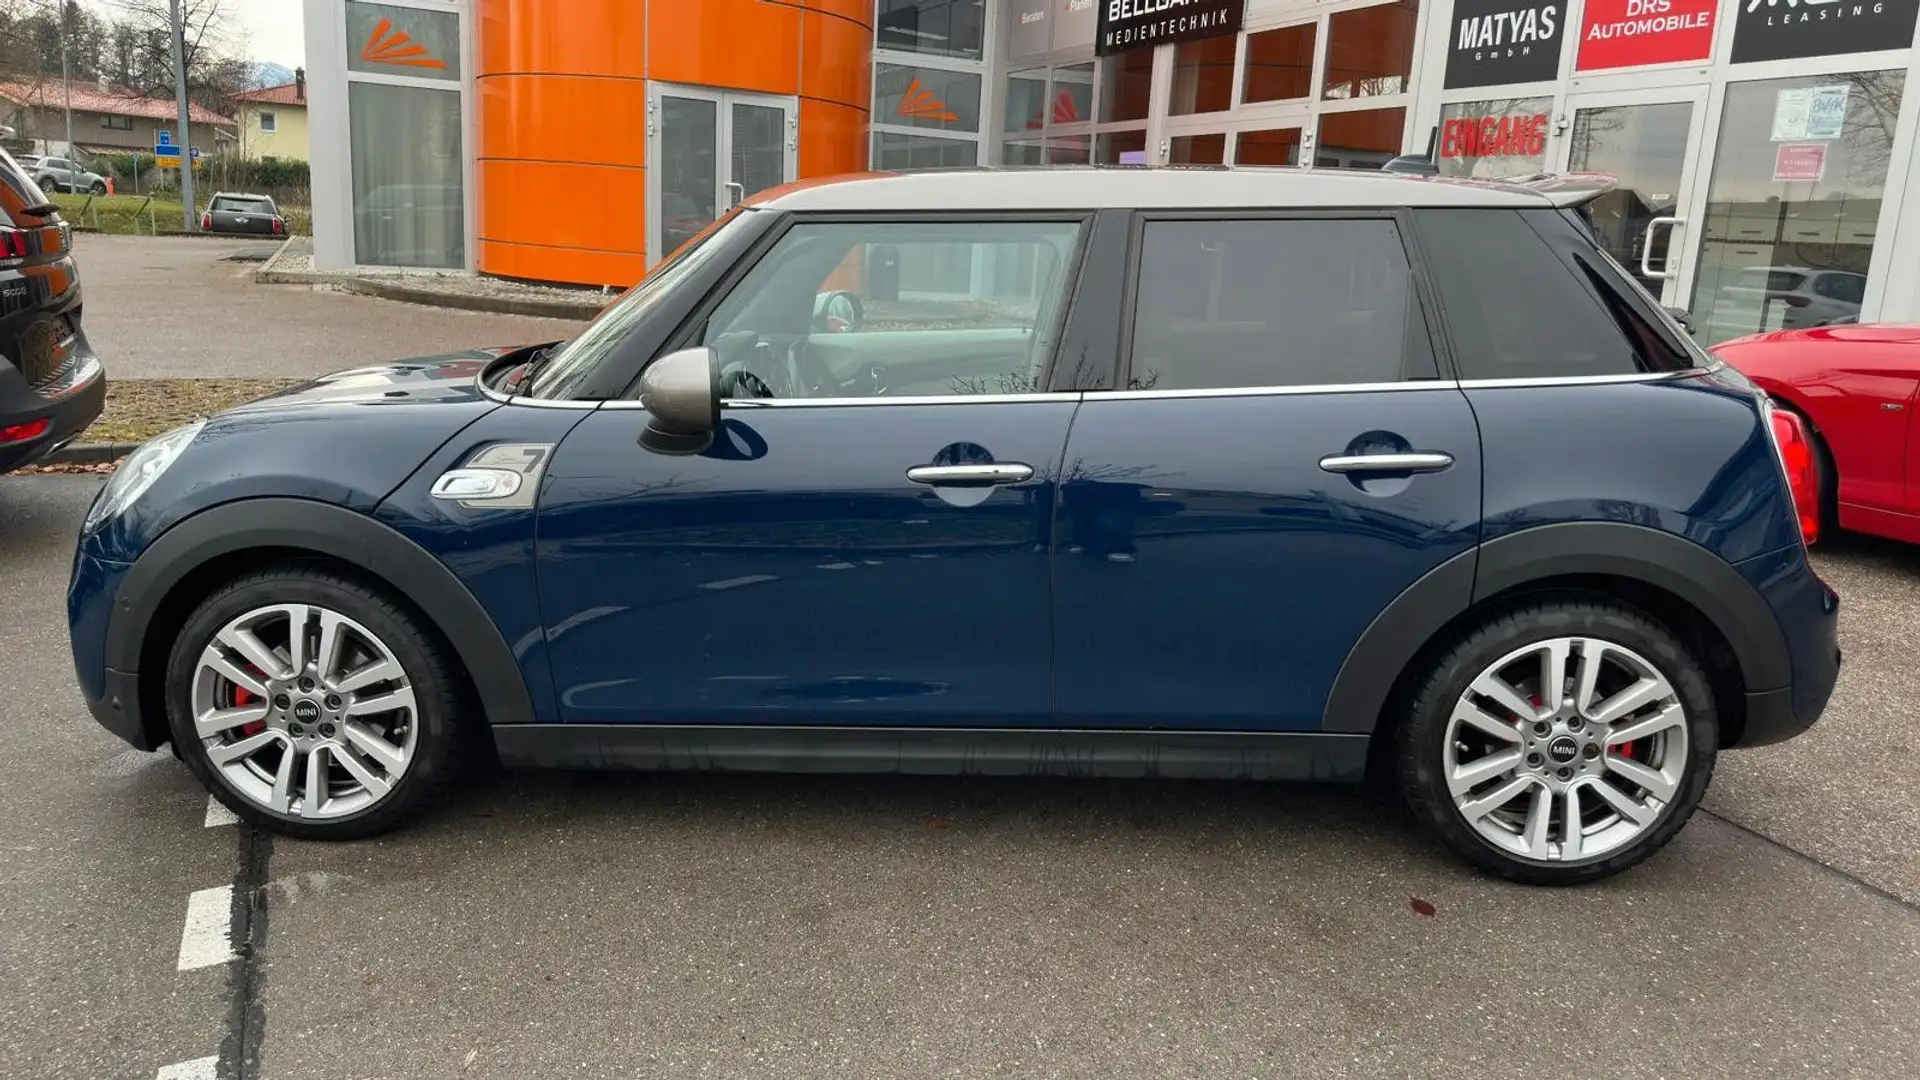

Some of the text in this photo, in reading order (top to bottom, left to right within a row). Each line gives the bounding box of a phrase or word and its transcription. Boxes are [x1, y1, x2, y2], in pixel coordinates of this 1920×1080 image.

[1108, 0, 1198, 21] BELLG
[1626, 0, 1671, 17] DRS
[1767, 3, 1883, 27] LEASING
[1106, 8, 1228, 47] MEDIENTECHNIK
[1457, 5, 1557, 50] MATYAS
[1587, 11, 1710, 41] AUTOMOBILE
[1474, 46, 1530, 61] GmbH
[1440, 113, 1547, 158] EINGANG
[523, 449, 546, 473] 7
[296, 708, 317, 717] MINI
[1553, 745, 1575, 755] MINI
